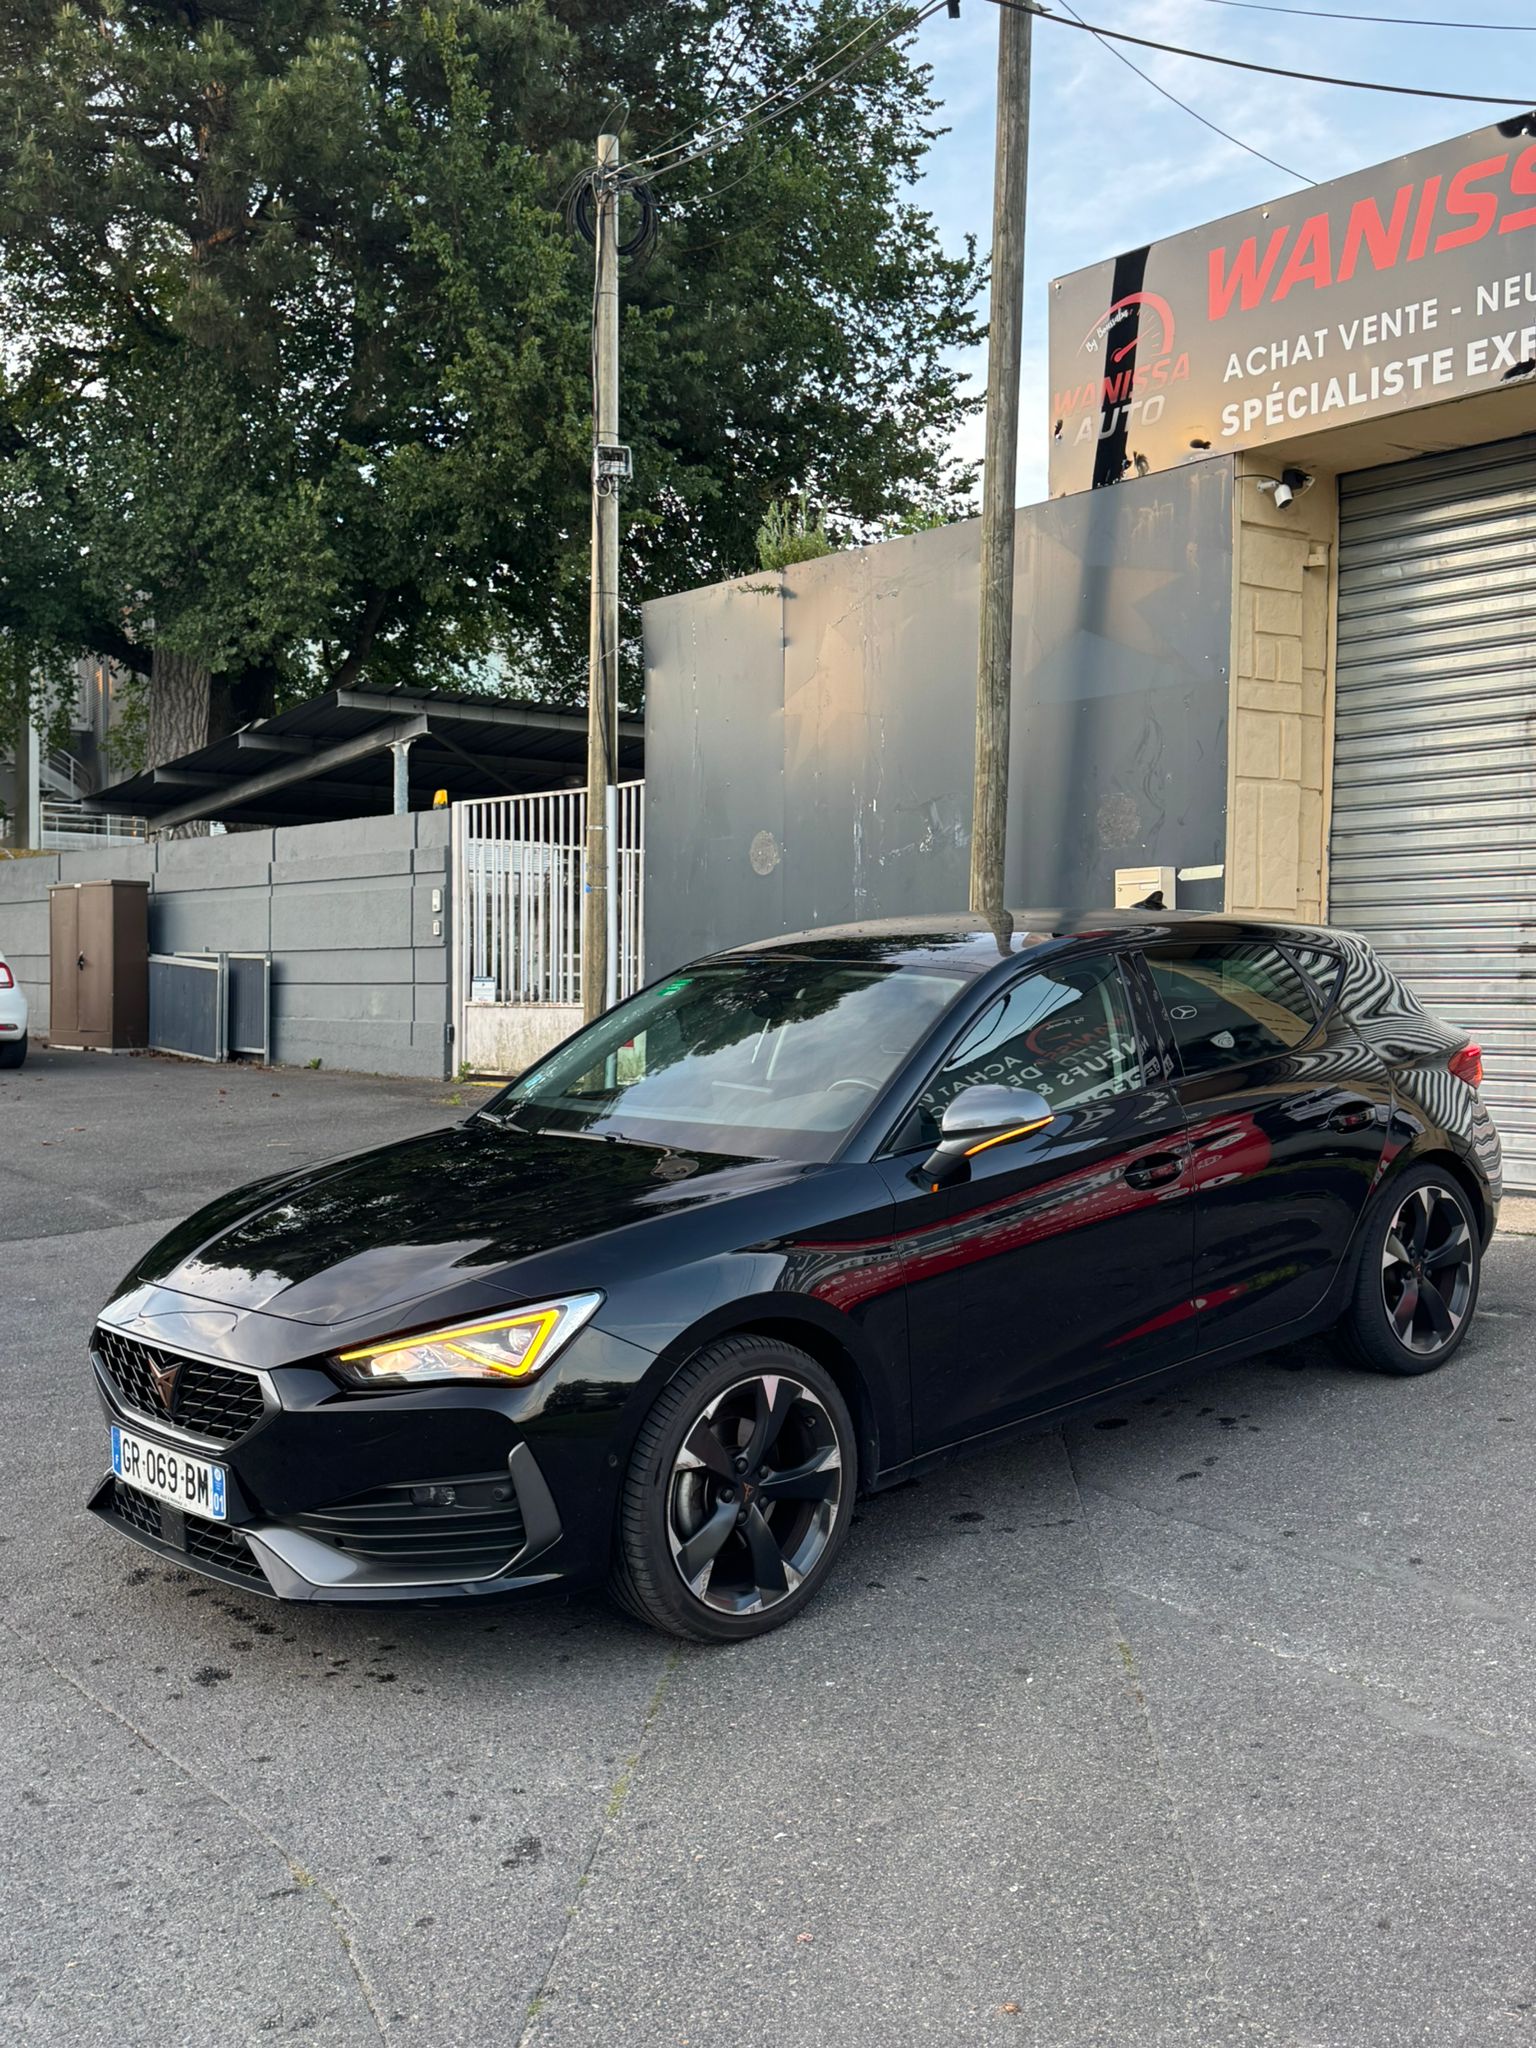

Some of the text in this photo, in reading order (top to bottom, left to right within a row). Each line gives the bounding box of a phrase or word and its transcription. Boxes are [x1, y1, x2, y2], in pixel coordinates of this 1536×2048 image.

[1223, 328, 1328, 383] ACHAT
[1338, 298, 1438, 350] VENTE
[1051, 352, 1191, 418] WANISSA
[1221, 347, 1454, 436] SPÉCIALISTE
[1073, 394, 1166, 447] AUTO
[122, 1438, 209, 1508] GR-069-BM
